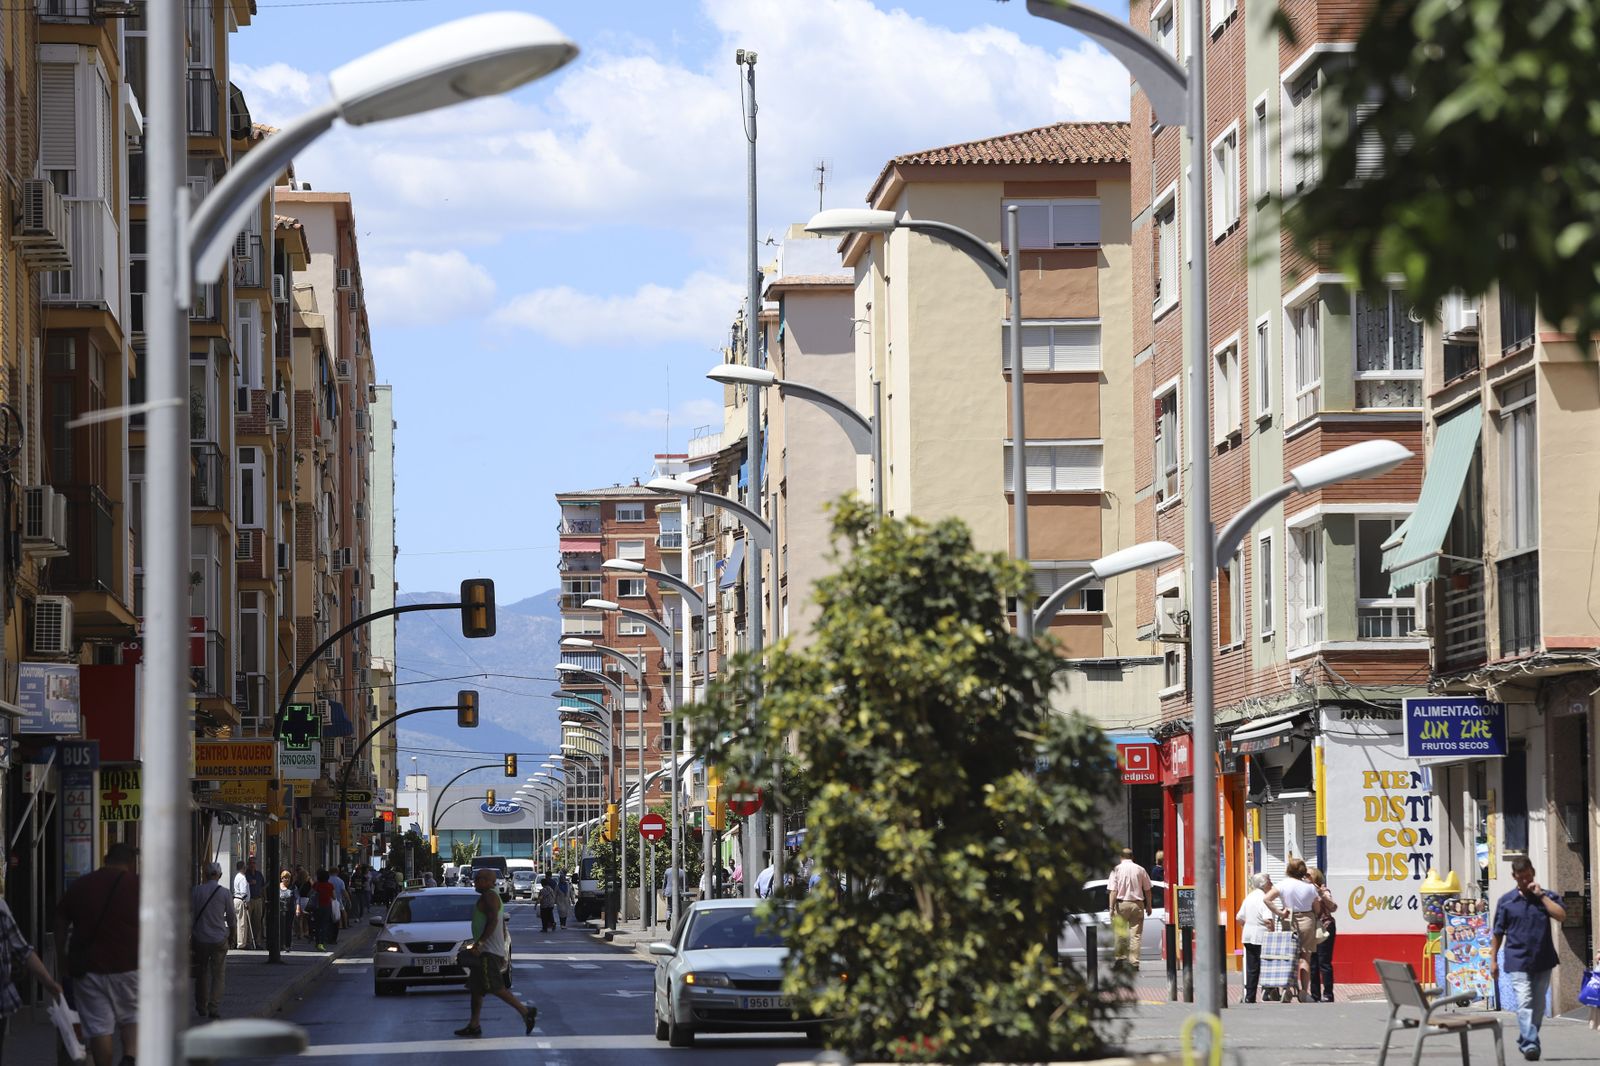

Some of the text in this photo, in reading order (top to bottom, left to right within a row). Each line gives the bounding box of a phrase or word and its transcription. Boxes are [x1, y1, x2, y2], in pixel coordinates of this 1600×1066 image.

[1413, 704, 1499, 718] ALIMENTACION
[1421, 741, 1489, 750] FRUTOS SECOS
[63, 747, 90, 766] BUS
[196, 744, 272, 760] CENTRO VAQUERO
[196, 765, 272, 776] ALMACENES SANCHEZ
[1121, 771, 1155, 782] redpiso
[100, 771, 140, 790] HORA
[67, 791, 85, 804] 64
[73, 807, 81, 818] 4
[487, 802, 512, 812] Ford
[1348, 886, 1419, 920] Come a
[749, 998, 774, 1008] 9561
